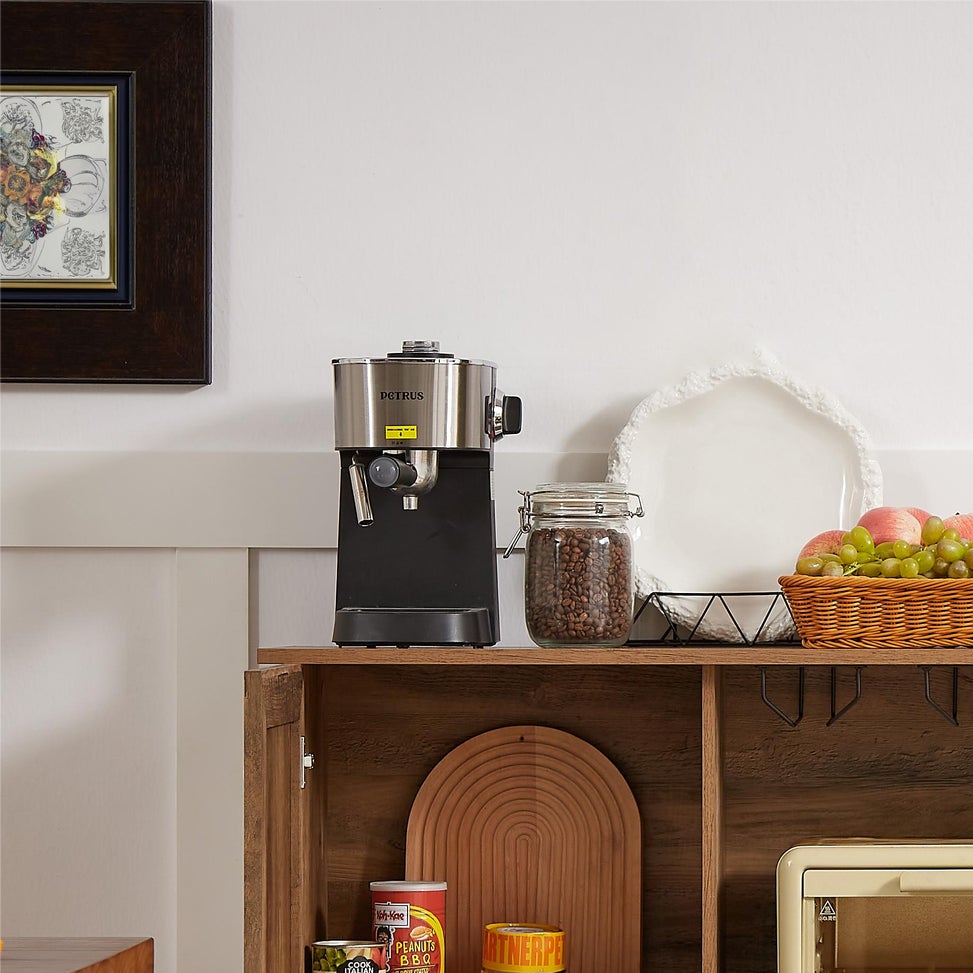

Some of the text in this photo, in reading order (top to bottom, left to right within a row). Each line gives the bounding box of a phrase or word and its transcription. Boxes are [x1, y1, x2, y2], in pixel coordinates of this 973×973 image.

[380, 391, 425, 400] PETRUS
[376, 910, 405, 920] Koh-Kae
[395, 940, 435, 954] PEANUTS
